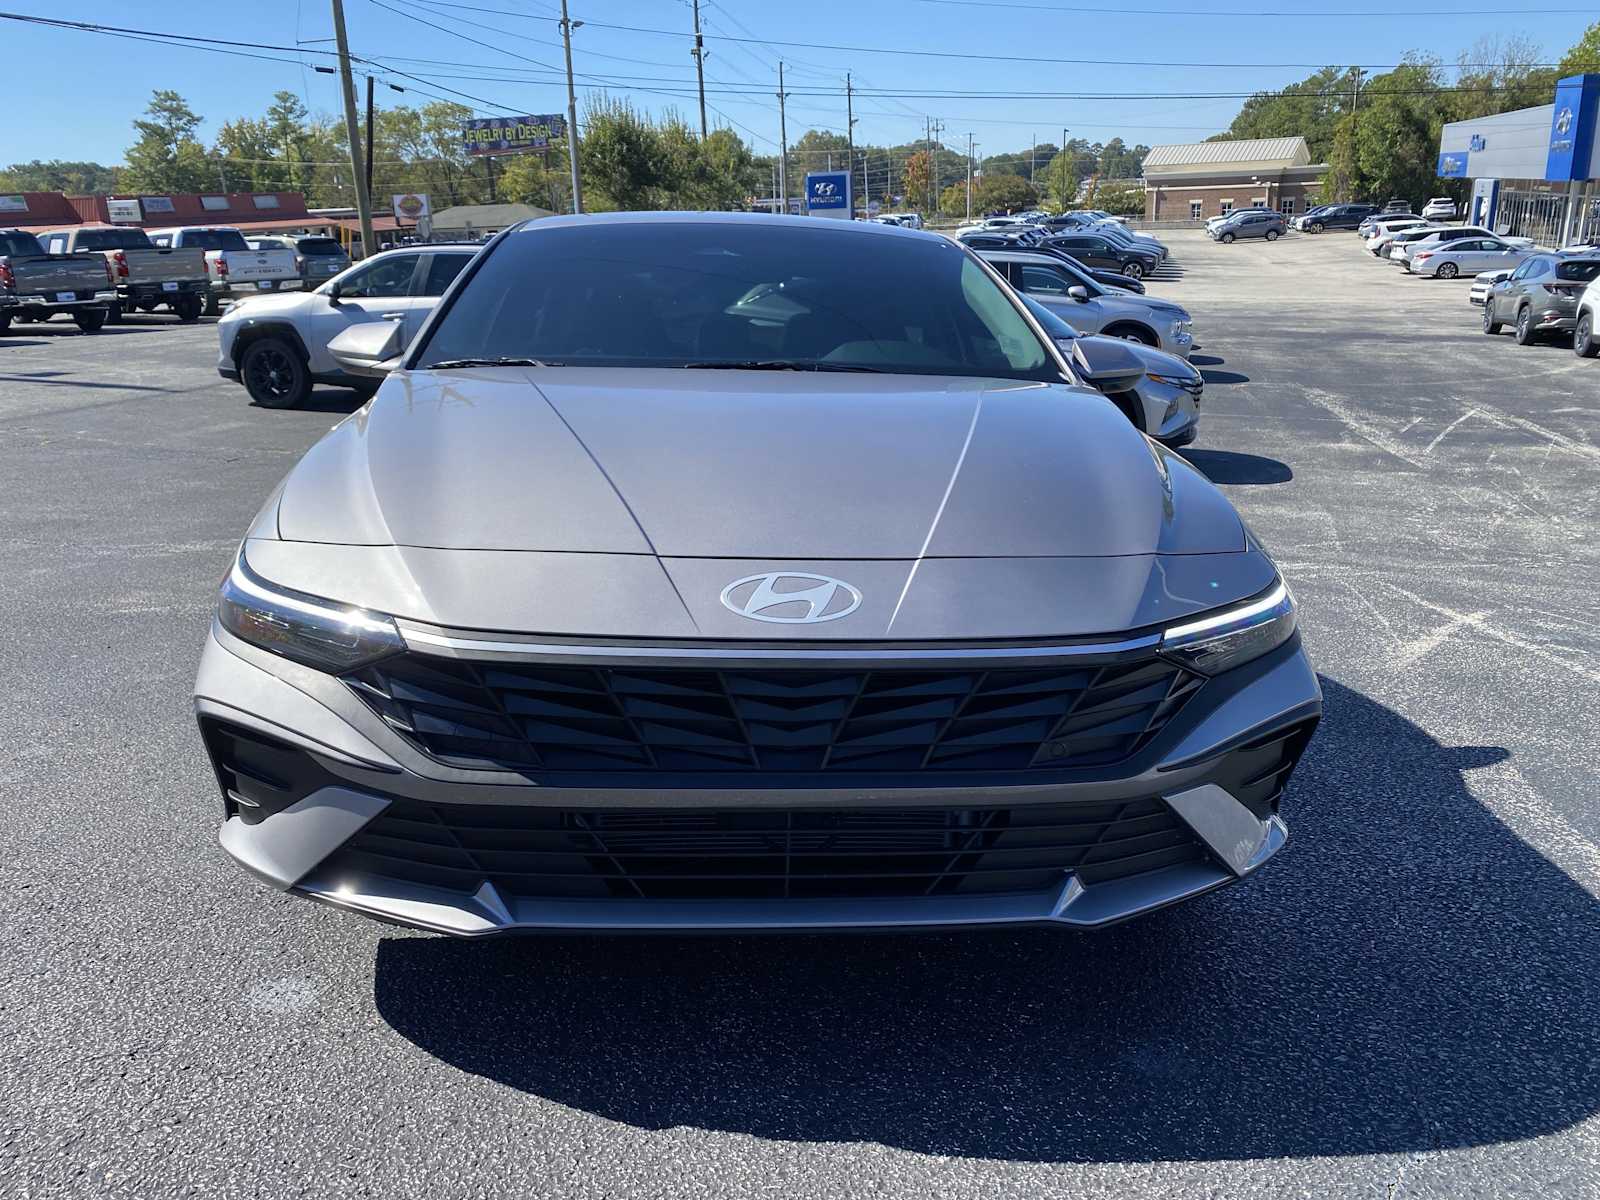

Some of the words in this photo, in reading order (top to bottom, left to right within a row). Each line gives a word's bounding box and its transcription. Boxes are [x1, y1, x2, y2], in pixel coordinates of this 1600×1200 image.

[464, 127, 503, 143] JEWELRY
[504, 127, 516, 140] BY
[517, 124, 552, 140] DESIGN
